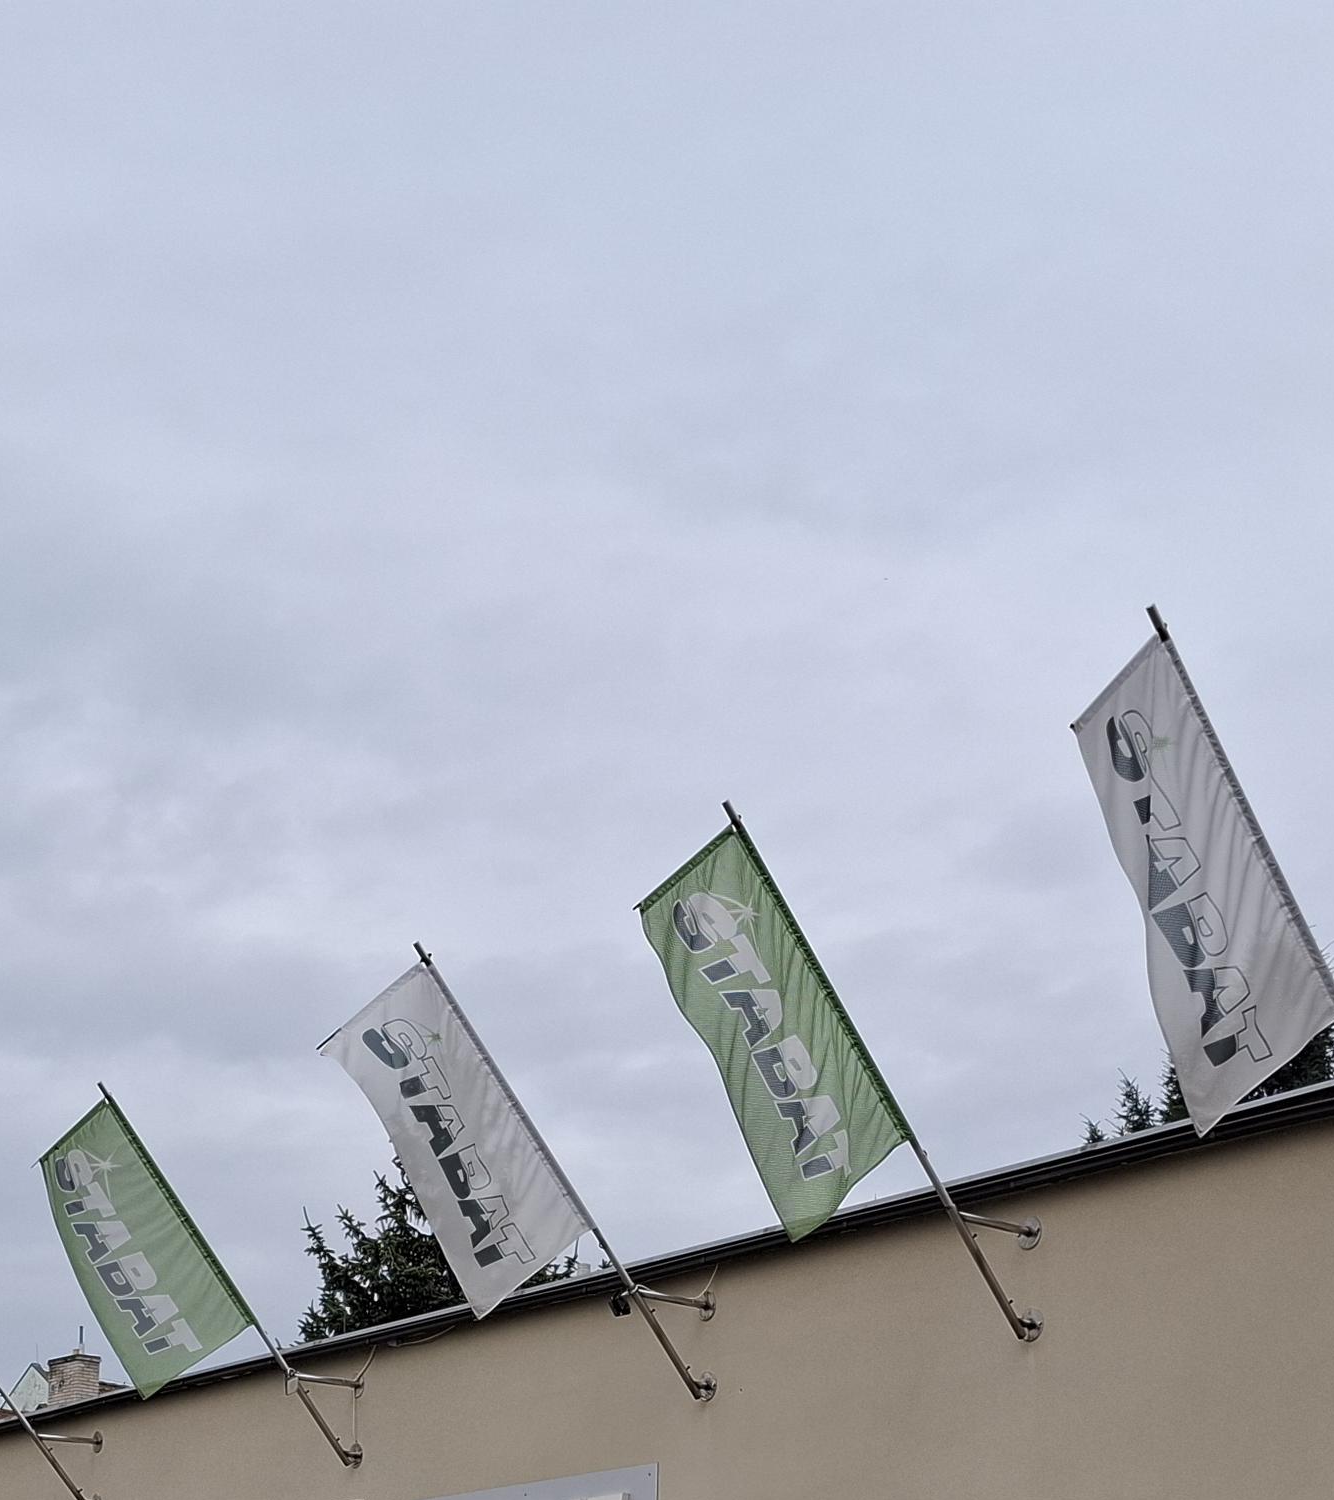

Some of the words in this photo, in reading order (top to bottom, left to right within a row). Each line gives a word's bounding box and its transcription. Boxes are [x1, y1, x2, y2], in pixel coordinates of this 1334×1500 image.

[1105, 708, 1274, 1069] STABAT
[361, 1017, 537, 1269] STABAT
[671, 891, 852, 1182] STABAT
[54, 1148, 203, 1355] STABAT
